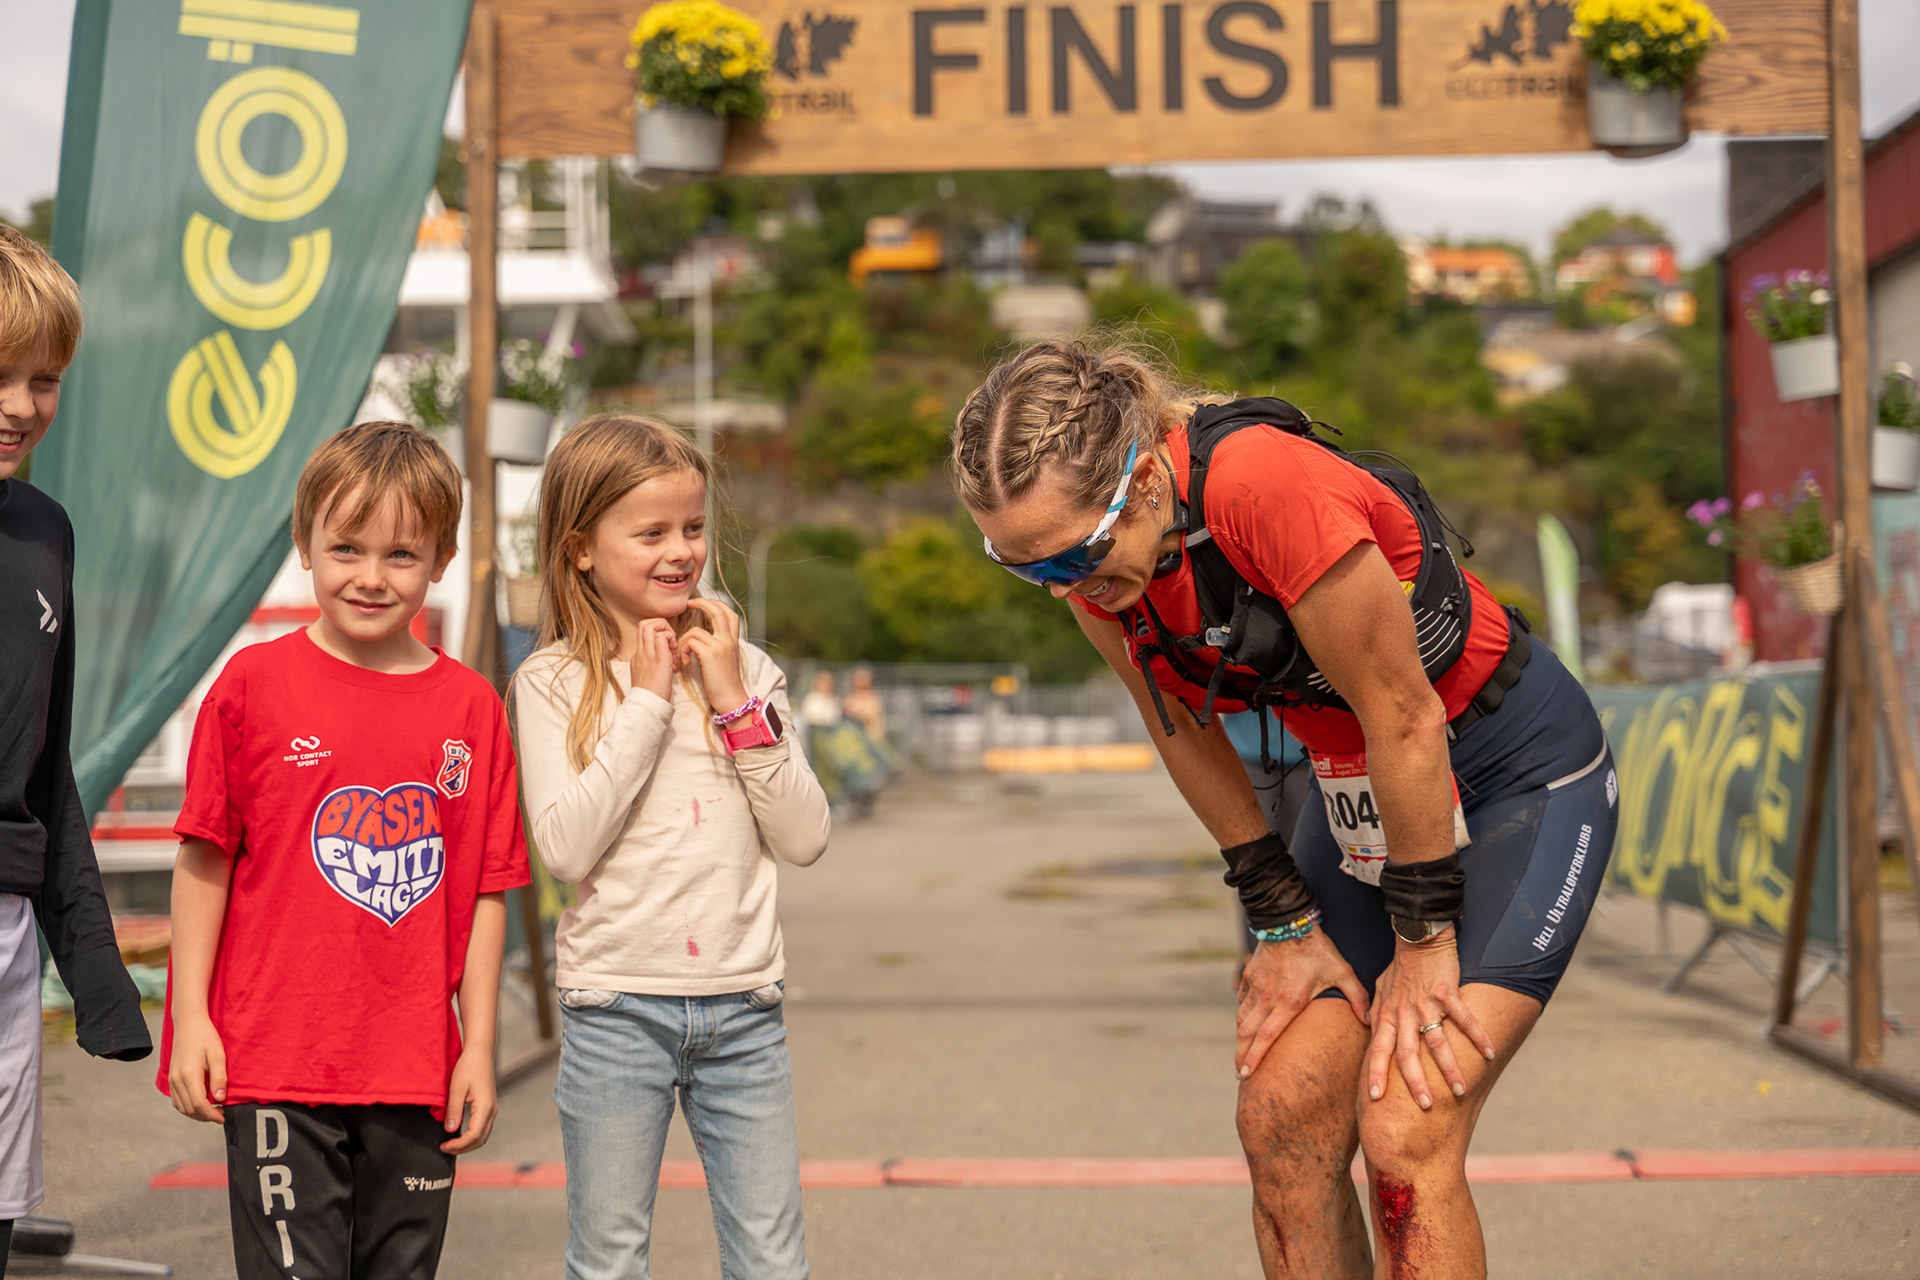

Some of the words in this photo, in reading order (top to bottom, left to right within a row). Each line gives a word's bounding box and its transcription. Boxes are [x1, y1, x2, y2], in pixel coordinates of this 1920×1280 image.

[912, 0, 1400, 117] FINISH
[283, 754, 299, 762] NOR
[300, 750, 333, 760] CONTACT
[296, 759, 319, 768] SPORT
[317, 788, 442, 848] BYÅSEN
